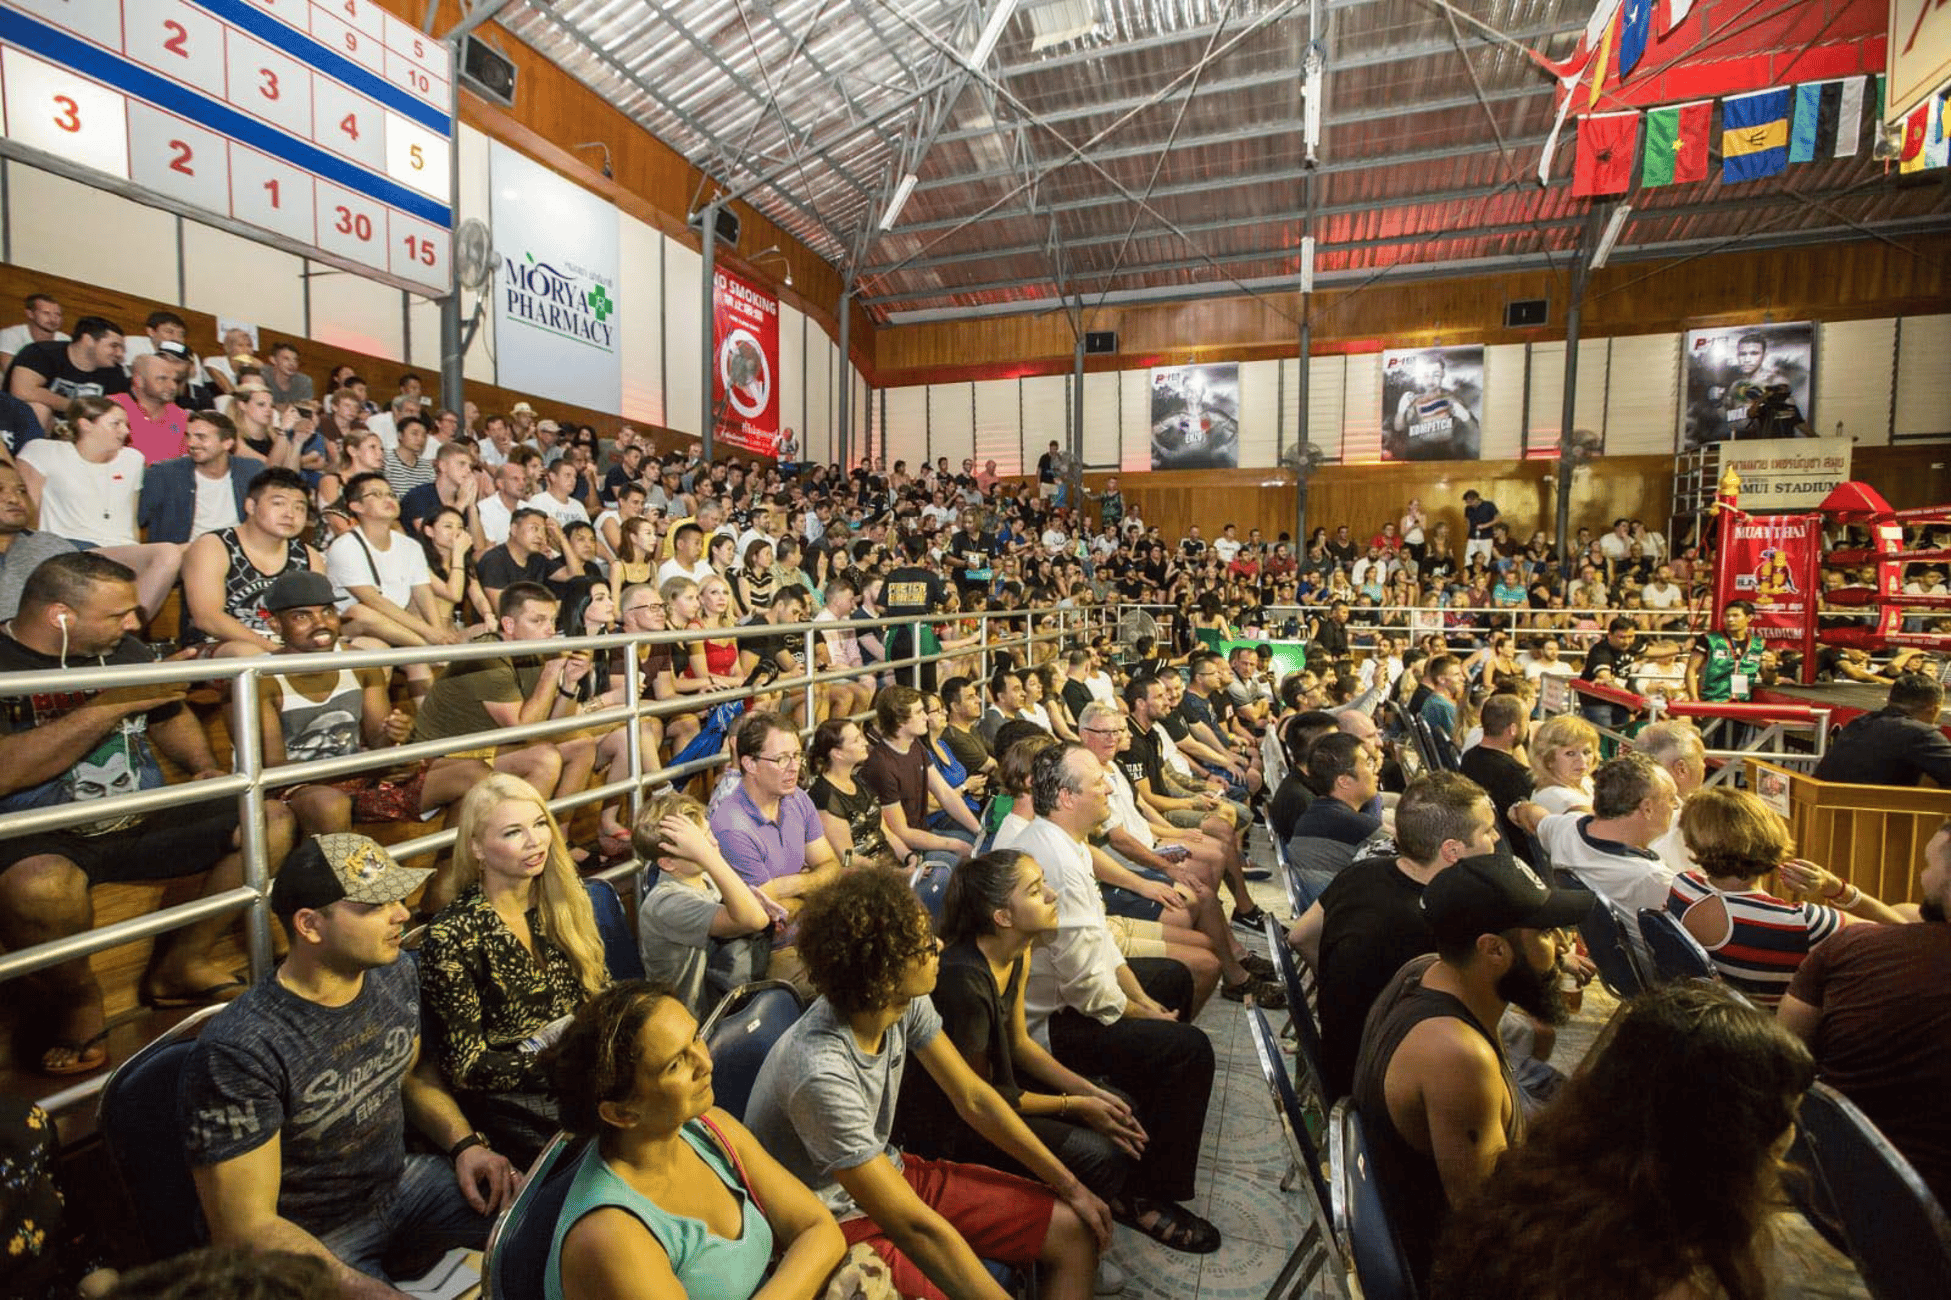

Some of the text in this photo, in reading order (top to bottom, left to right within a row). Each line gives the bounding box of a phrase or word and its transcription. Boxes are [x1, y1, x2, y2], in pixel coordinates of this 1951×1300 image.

[345, 32, 429, 93] 9 10
[413, 40, 424, 59] 5
[163, 19, 425, 171] 2 3 4 5
[53, 95, 436, 267] 3 2 1 30 15
[506, 257, 589, 315] MORYA
[729, 280, 776, 316] SMOKING
[507, 288, 613, 347] PHARMACY
[1738, 483, 1768, 494] MUI
[1757, 627, 1803, 640] STADIUM
[1125, 762, 1143, 772] UAY
